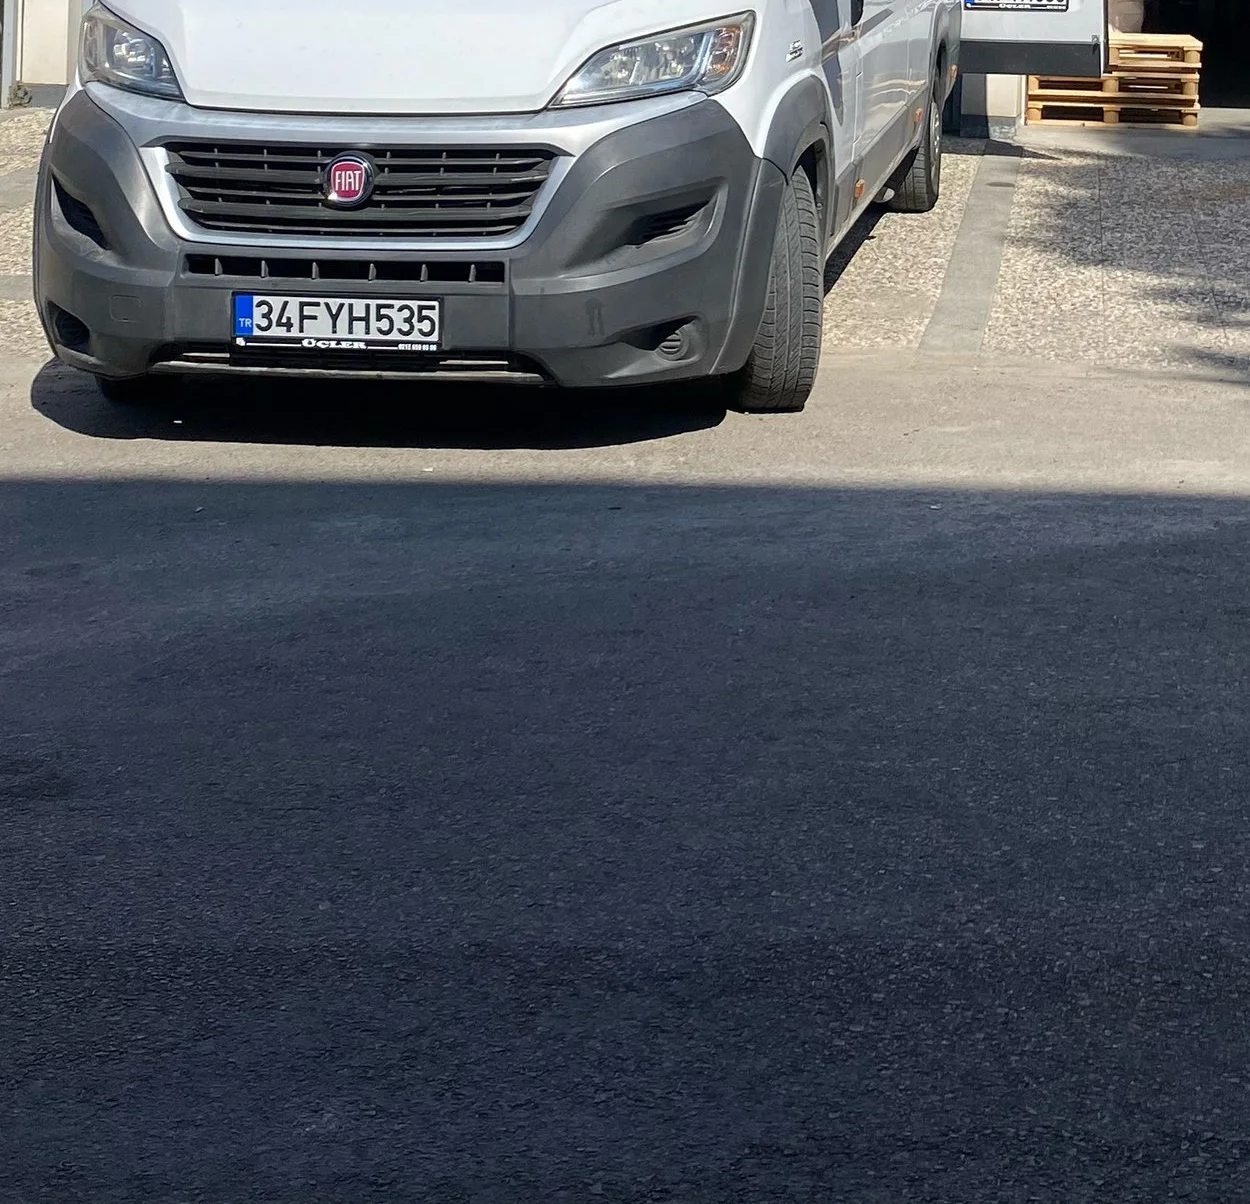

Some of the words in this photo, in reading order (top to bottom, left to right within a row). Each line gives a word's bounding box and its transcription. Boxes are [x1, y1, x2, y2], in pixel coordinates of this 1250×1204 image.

[335, 170, 361, 191] FIAT
[239, 318, 252, 328] TR
[254, 299, 436, 337] 34FYH535
